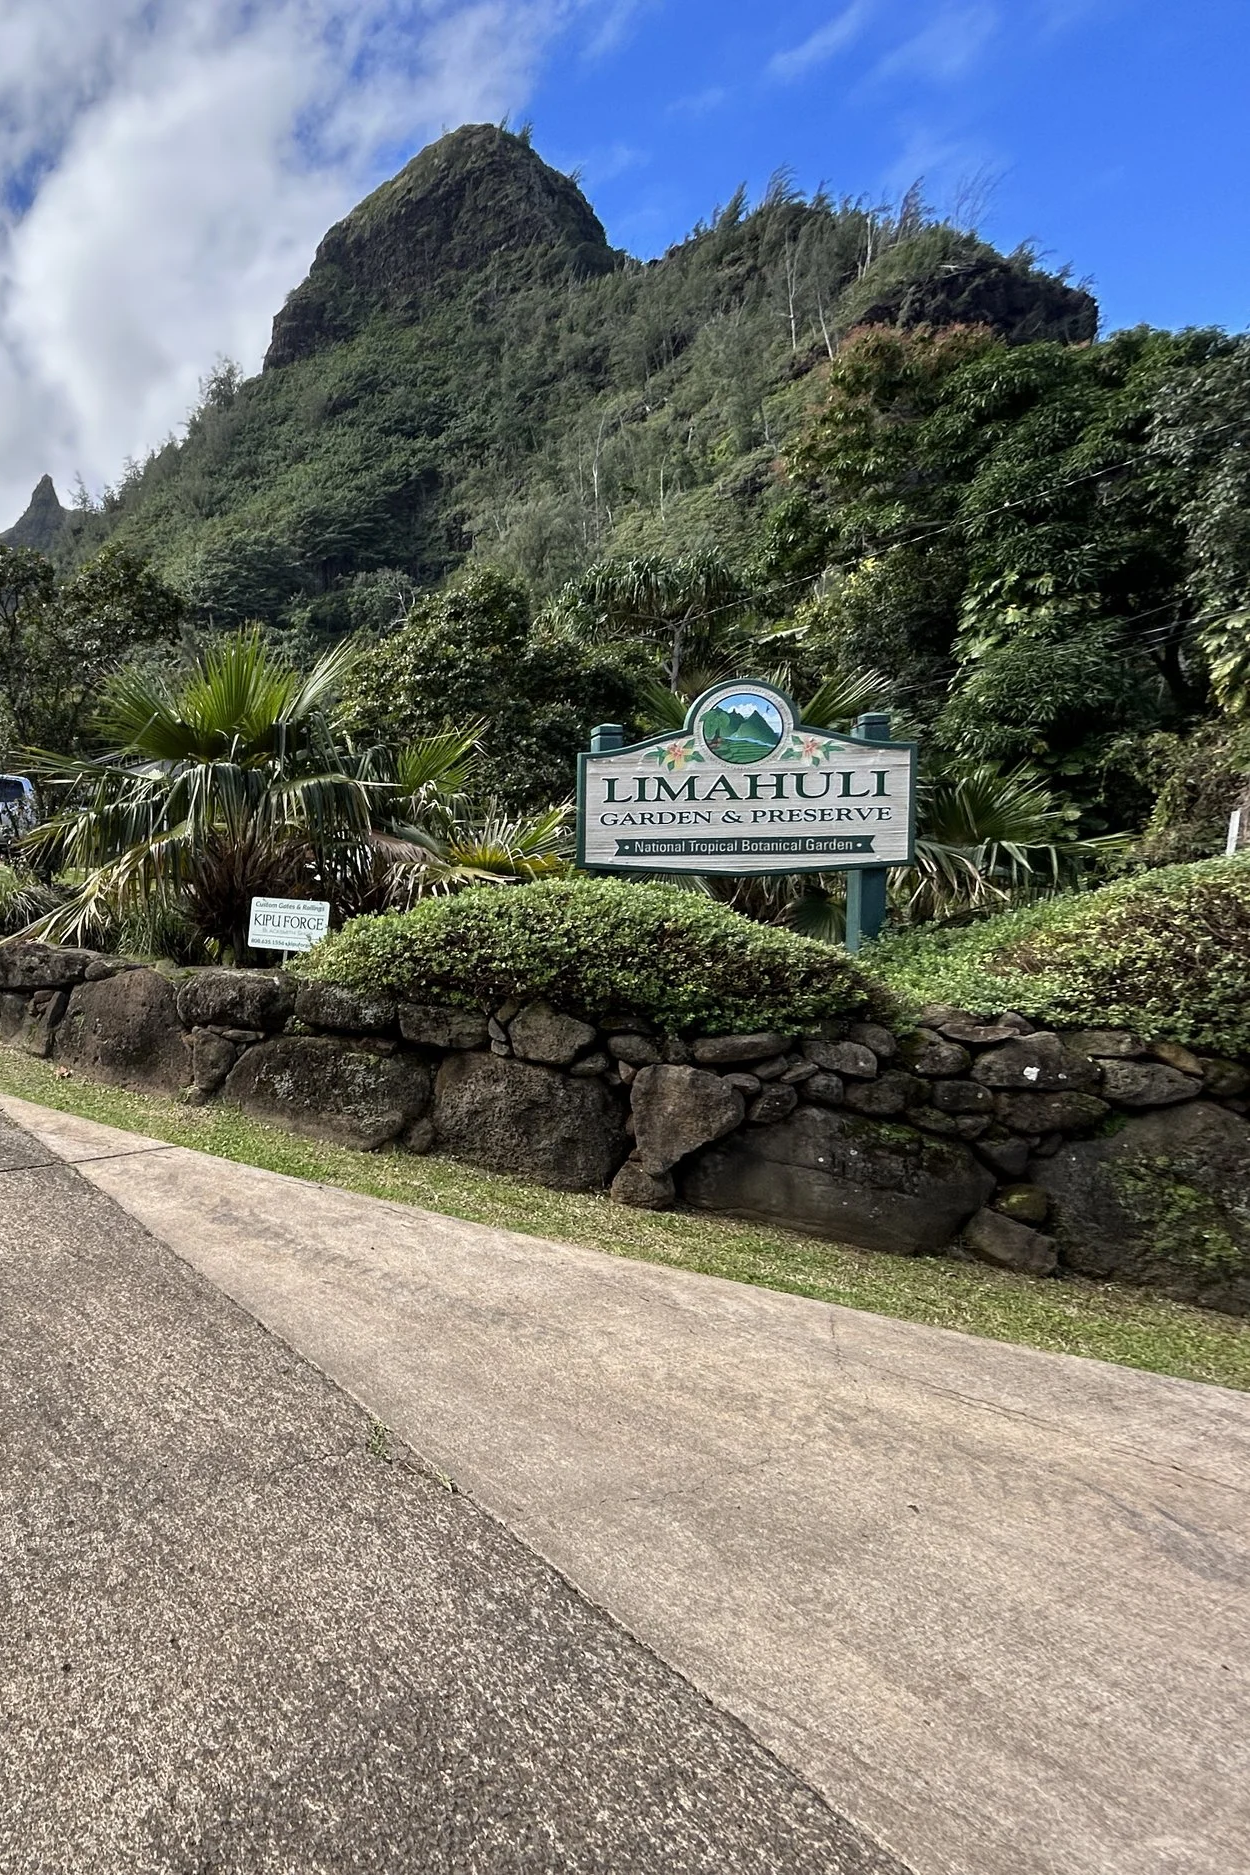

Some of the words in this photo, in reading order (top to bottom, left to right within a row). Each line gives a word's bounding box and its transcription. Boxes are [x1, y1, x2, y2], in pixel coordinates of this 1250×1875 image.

[602, 770, 892, 803] LIMAHULI
[600, 811, 712, 826] GARDEN
[721, 810, 743, 823] &
[750, 807, 892, 823] PRESERVE
[634, 840, 685, 853] National
[688, 840, 738, 854] Tropical
[742, 839, 803, 852] Botanical
[805, 838, 853, 851] Garden
[255, 901, 277, 909] Custom
[254, 914, 281, 928] KIPU
[283, 916, 324, 931] FORGE
